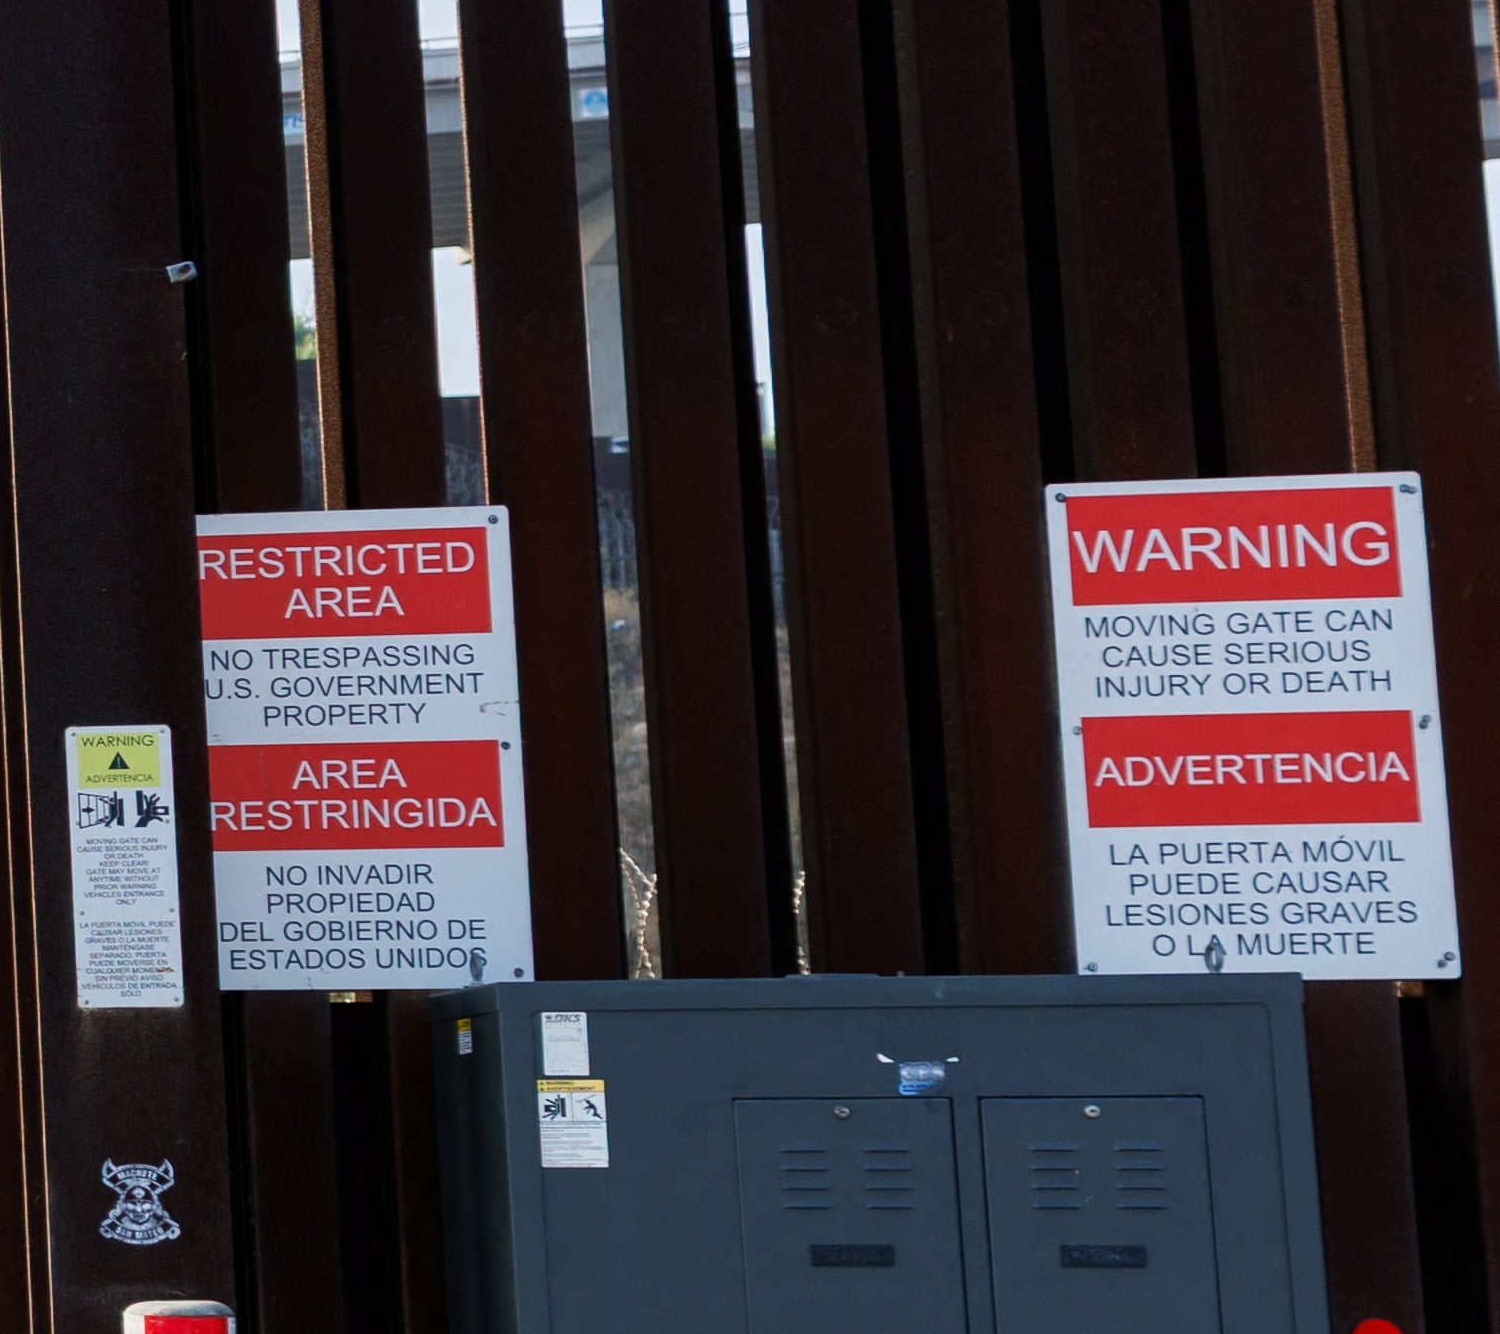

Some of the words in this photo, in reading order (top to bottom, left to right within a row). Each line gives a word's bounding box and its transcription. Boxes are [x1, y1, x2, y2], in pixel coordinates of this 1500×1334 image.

[1072, 520, 1391, 575] WARNING
[199, 541, 475, 581] RESTRICTED
[284, 584, 406, 619] AREA
[1084, 613, 1216, 639] MOVING
[1226, 611, 1314, 635] GATE
[1324, 609, 1394, 634] CAN
[210, 648, 254, 672] NO
[262, 643, 476, 670] TRESPASSING
[1102, 643, 1214, 668] CAUSE
[1223, 640, 1371, 666] SERIOUS
[205, 677, 260, 700] U.S.
[270, 672, 485, 699] GOVERNMENT
[1094, 673, 1209, 699] INJURY
[1222, 672, 1272, 695] OR
[1282, 669, 1392, 695] DEATH
[263, 703, 426, 729] PROPERTY
[81, 735, 154, 748] WARNING
[85, 774, 153, 783] ADVERTENCIA
[292, 759, 407, 791] AREA
[1094, 751, 1411, 788] ADVERTENCIA
[211, 797, 498, 831] RESTRINGIDA
[1109, 843, 1148, 866] LA
[1159, 840, 1291, 865] PUERTA
[1302, 834, 1405, 864] MÓVIL
[265, 864, 307, 887] NO
[317, 863, 434, 886] INVADIR
[1129, 872, 1241, 897] PUEDE
[1252, 870, 1390, 895] CAUSAR
[84, 891, 122, 899] VEHICLES
[266, 891, 436, 915] PROPIEDAD
[91, 921, 122, 929] PUERTA
[1106, 903, 1270, 928] LESIONES
[1280, 900, 1418, 926] GRAVES
[85, 937, 116, 945] GRAVES
[137, 935, 170, 943] MUERTE
[91, 929, 123, 937] CAUSAR
[124, 928, 162, 936] LESIONES
[219, 920, 276, 943] DEL
[283, 919, 439, 943] GOBIERNO
[447, 919, 486, 941] DE
[1152, 934, 1176, 956] O
[1187, 933, 1228, 956] LA
[1236, 932, 1377, 956] MUERTE
[85, 967, 130, 975] CUALQUIER
[229, 948, 366, 971] ESTADOS
[375, 946, 488, 970] UNIDOS
[140, 981, 177, 989] ENTRADA
[554, 1014, 581, 1023] DKS
